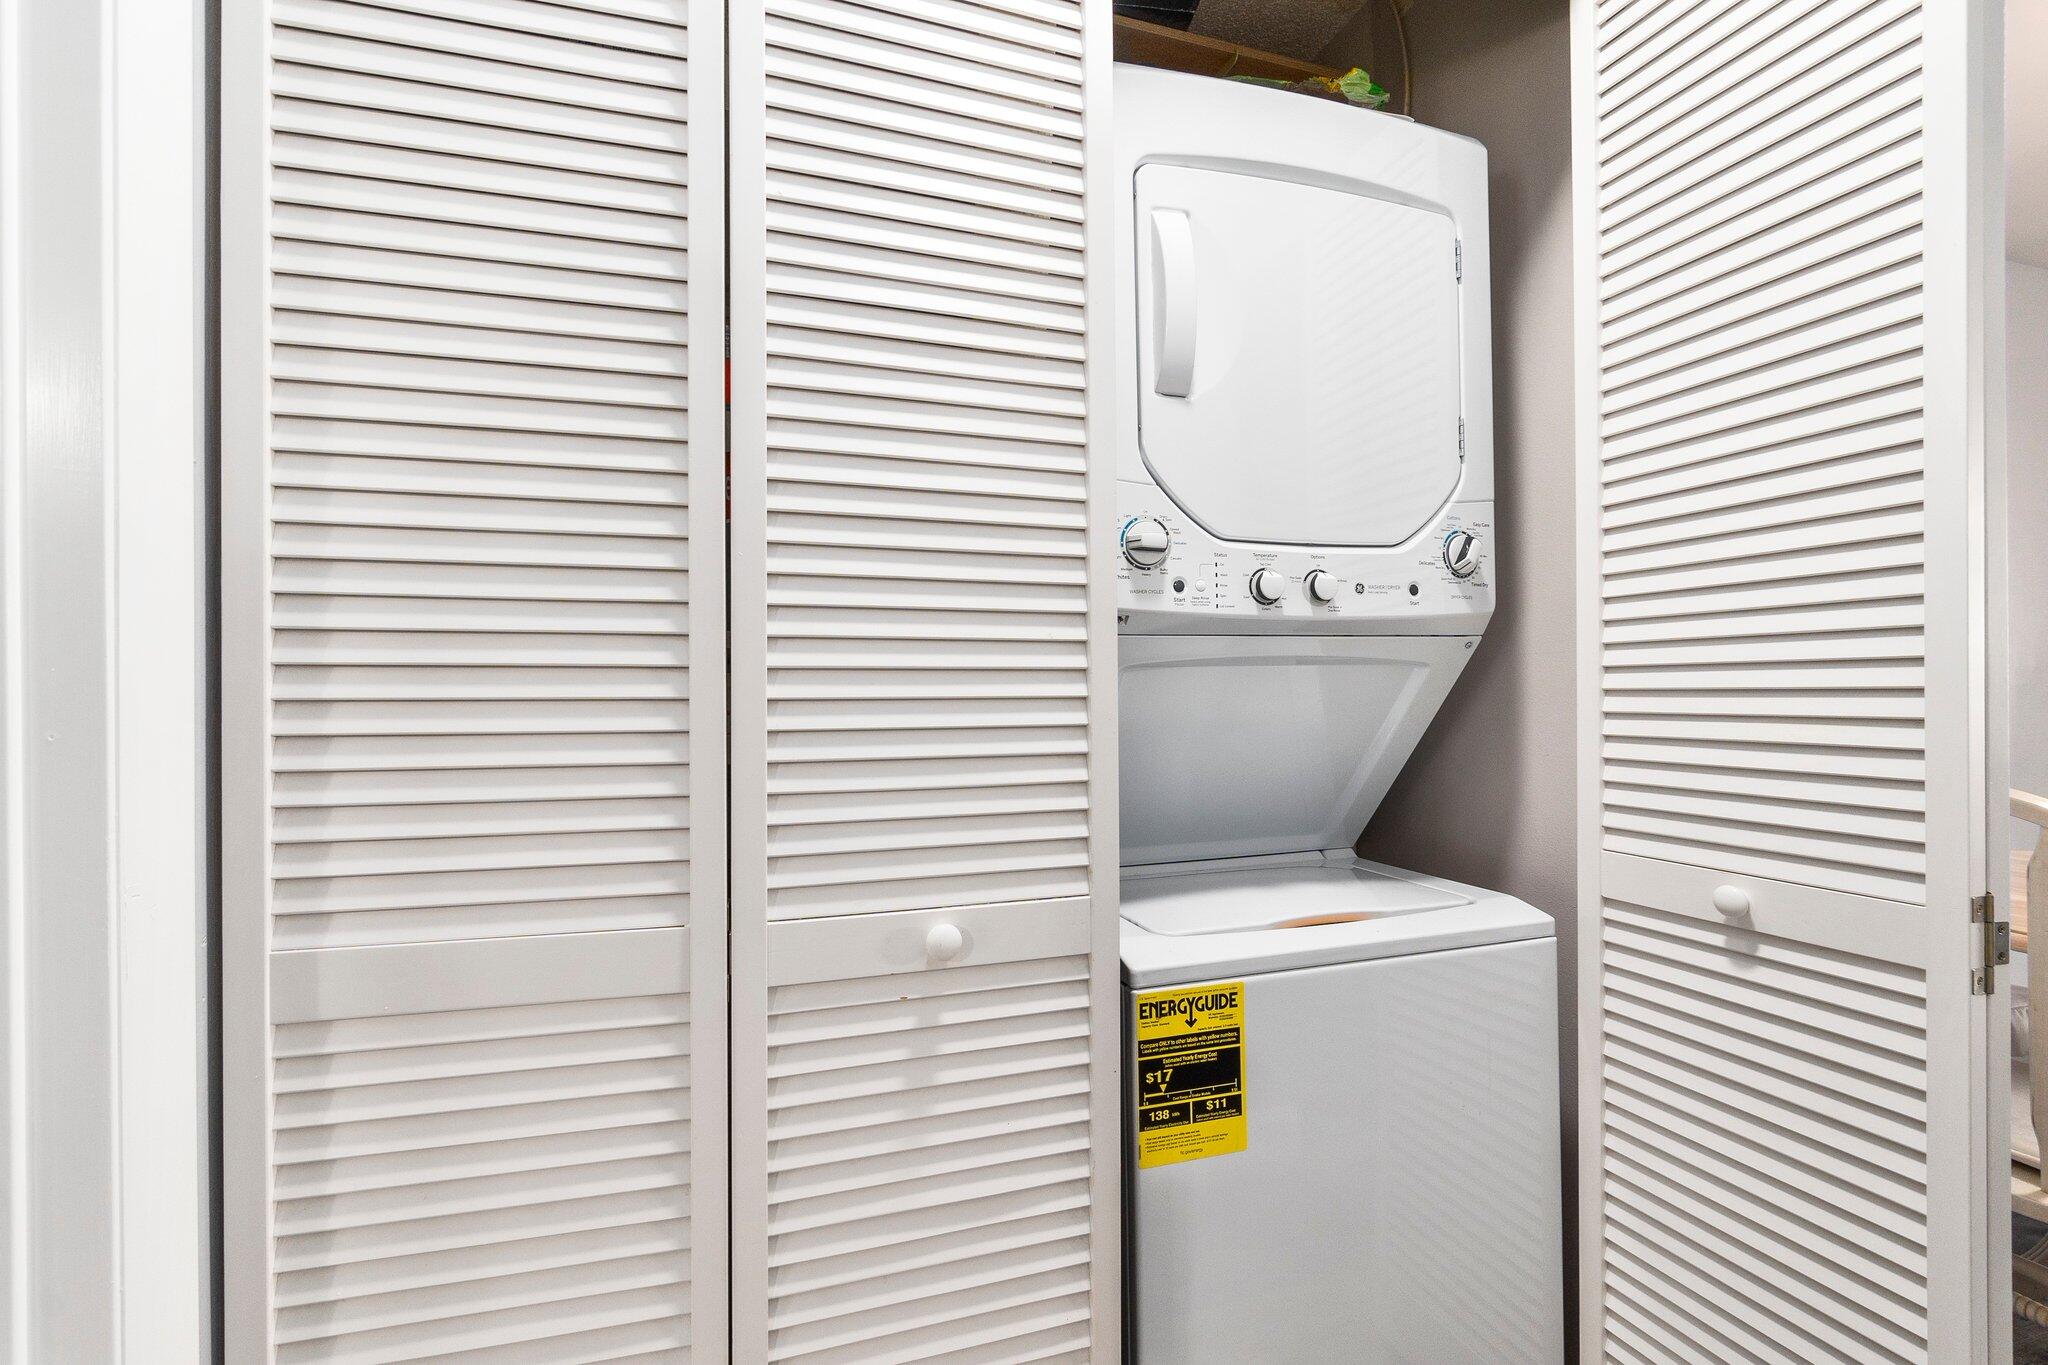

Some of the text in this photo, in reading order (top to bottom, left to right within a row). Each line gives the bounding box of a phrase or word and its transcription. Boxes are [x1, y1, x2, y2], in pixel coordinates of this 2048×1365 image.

[1139, 992, 1238, 1020] ENERGYGUIDE
[1146, 1069, 1173, 1084] $17
[1206, 1098, 1226, 1110] $11
[1149, 1110, 1170, 1121] 138
